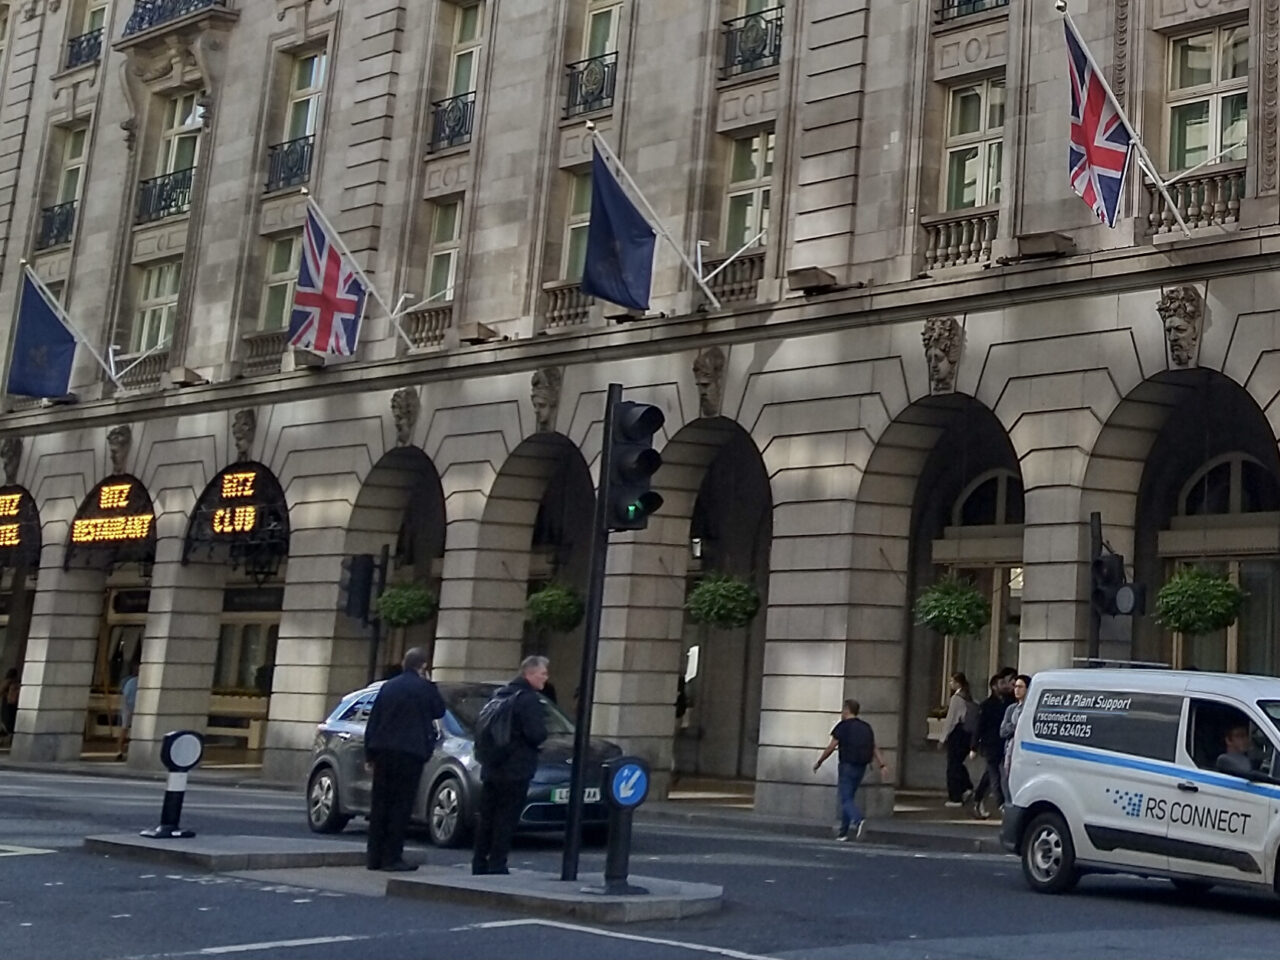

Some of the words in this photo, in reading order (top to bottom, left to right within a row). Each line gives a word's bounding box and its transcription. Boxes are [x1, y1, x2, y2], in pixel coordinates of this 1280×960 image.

[100, 484, 132, 509] RITZ
[222, 472, 256, 498] RITZ
[0, 494, 22, 516] ITZ
[72, 514, 154, 542] RESTAURANT
[213, 506, 256, 533] CLUB
[0, 524, 20, 546] TEL
[1042, 693, 1065, 706] Fleet
[1064, 693, 1072, 706] &
[1072, 694, 1096, 708] Plant
[1095, 695, 1132, 711] Support
[1037, 713, 1087, 723] rsconnect.com
[1034, 722, 1059, 735] 01675
[1059, 723, 1092, 738] 624025
[1145, 797, 1167, 820] RS
[1170, 801, 1251, 835] CONNECT
